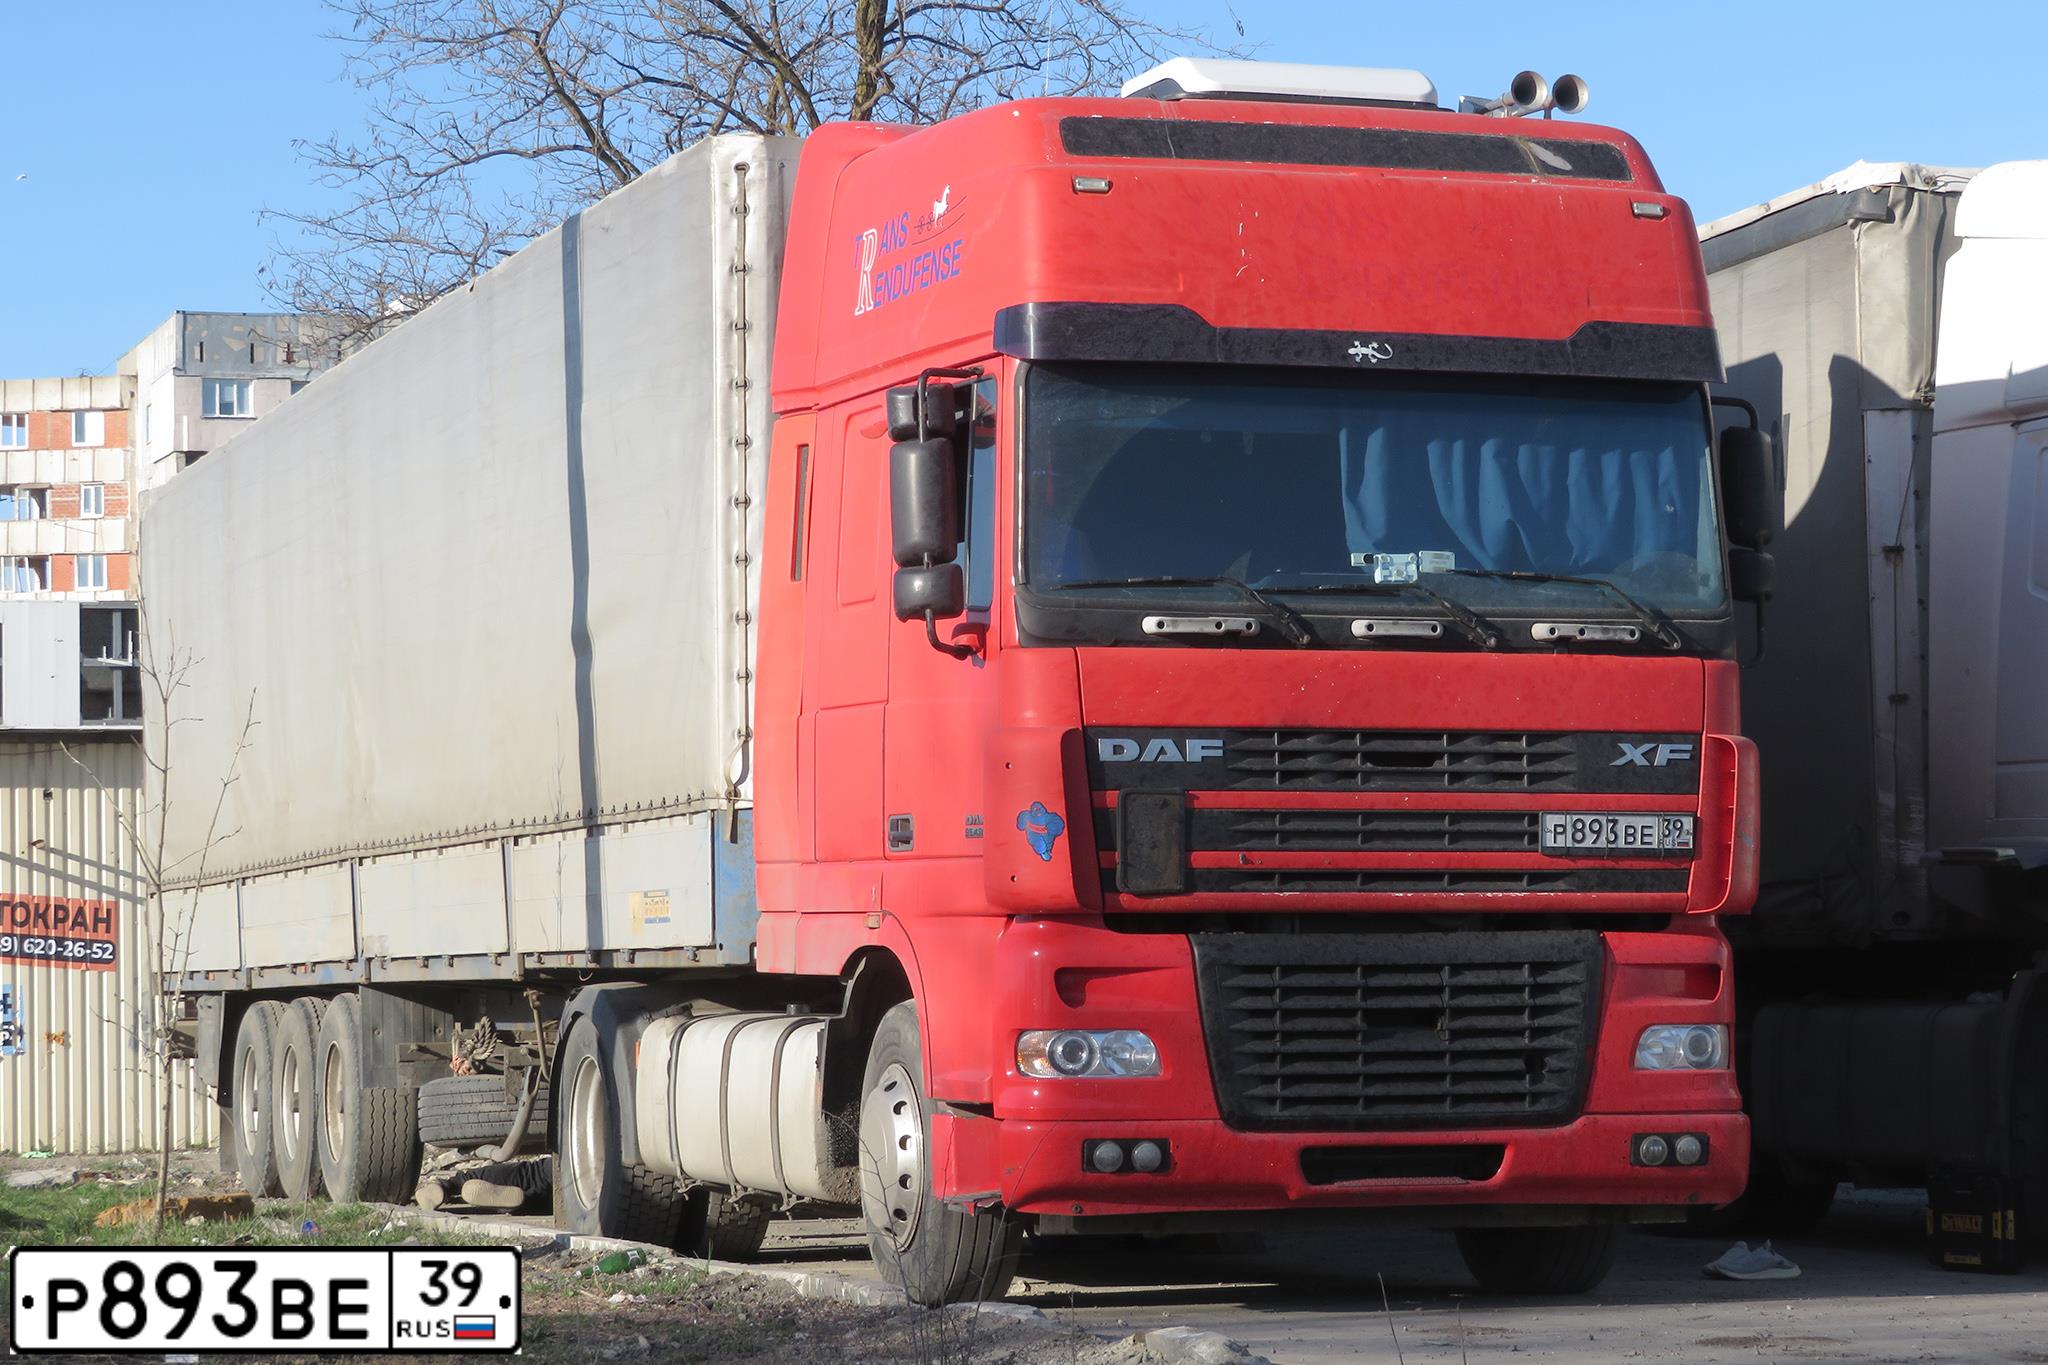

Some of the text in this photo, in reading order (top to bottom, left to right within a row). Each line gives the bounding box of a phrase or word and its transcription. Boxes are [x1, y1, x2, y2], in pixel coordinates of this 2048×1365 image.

[1098, 738, 1224, 763] DAF
[1608, 742, 1694, 767] XF
[1663, 817, 1684, 839] 39
